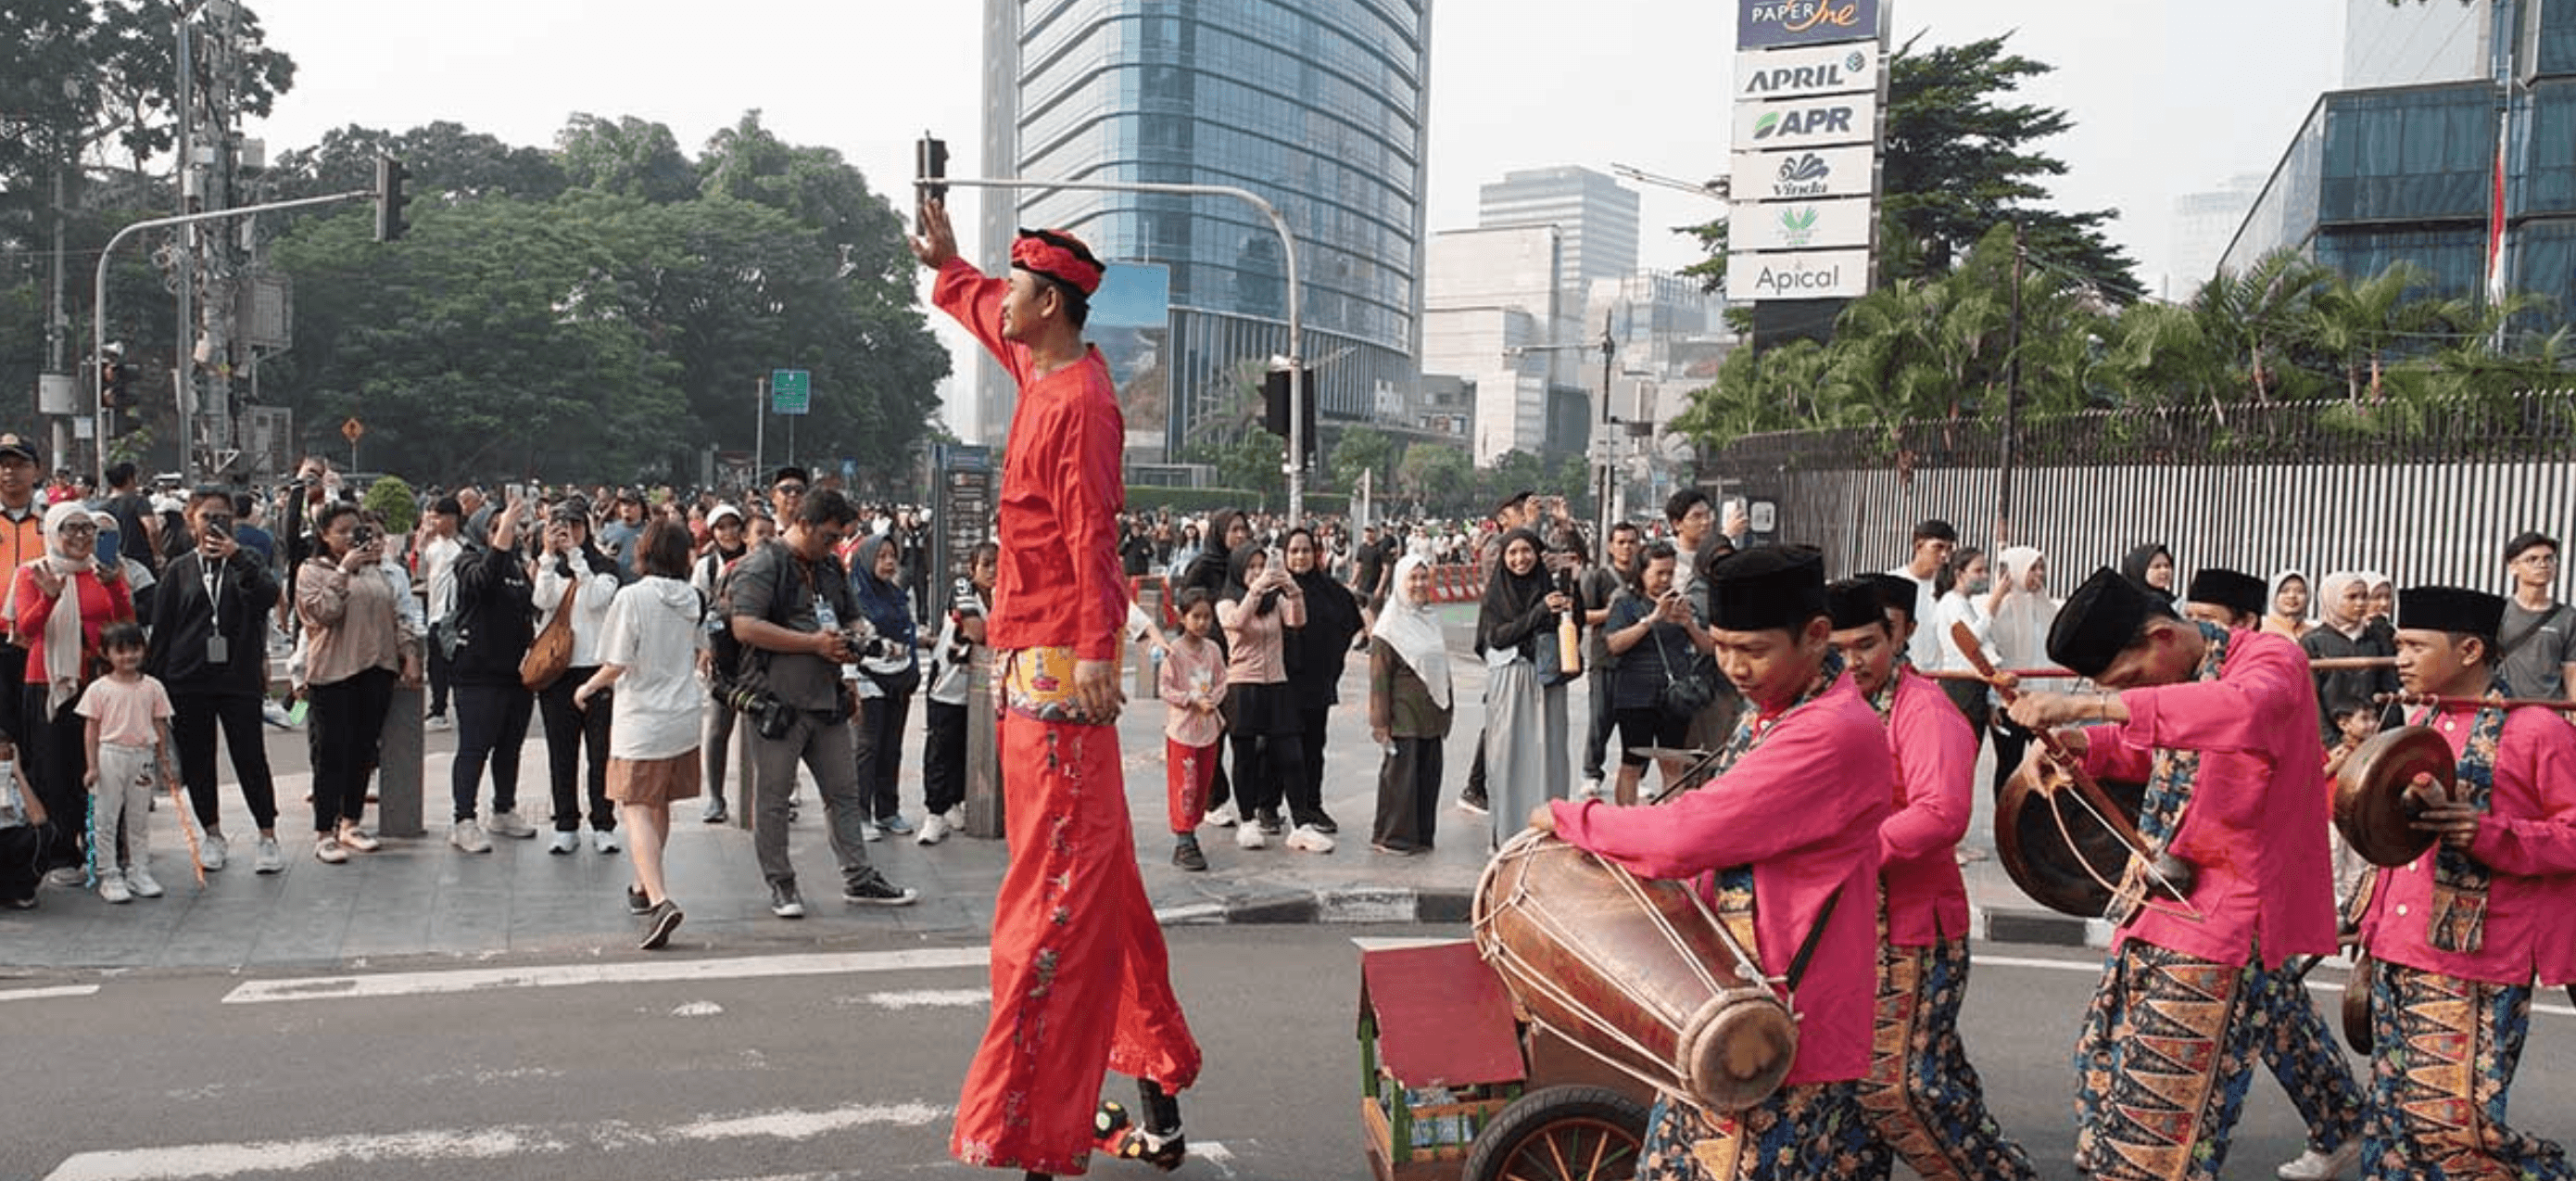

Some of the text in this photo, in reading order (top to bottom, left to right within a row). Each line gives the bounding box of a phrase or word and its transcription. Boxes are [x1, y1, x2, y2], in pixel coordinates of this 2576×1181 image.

[1751, 3, 1815, 22] PAPER
[1745, 64, 1845, 93] APRIL
[1775, 107, 1853, 137] APR
[1773, 181, 1828, 196] Vinda
[1754, 265, 1839, 296] Apical
